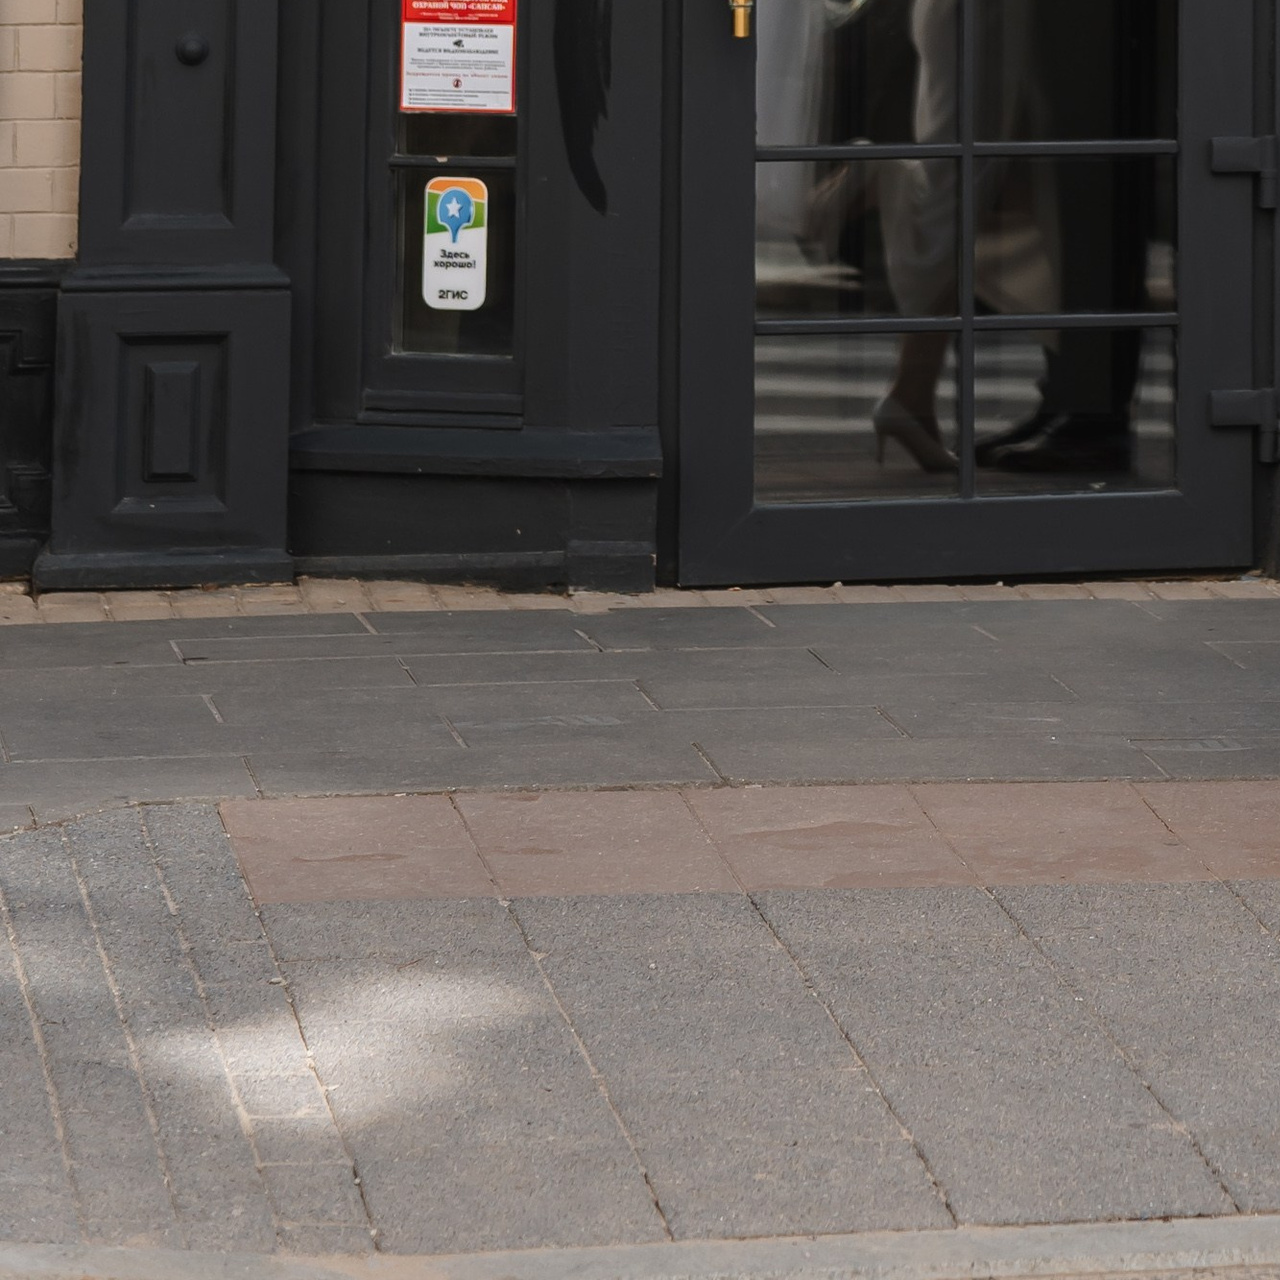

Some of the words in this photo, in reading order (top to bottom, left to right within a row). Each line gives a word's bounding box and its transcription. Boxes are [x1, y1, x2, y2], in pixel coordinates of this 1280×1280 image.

[412, 1, 449, 9] ОХРАНОЙ
[450, 2, 467, 10] ЧОП
[440, 249, 470, 259] Здесь
[433, 259, 477, 270] хорошо!
[438, 289, 469, 300] 2ГИС
